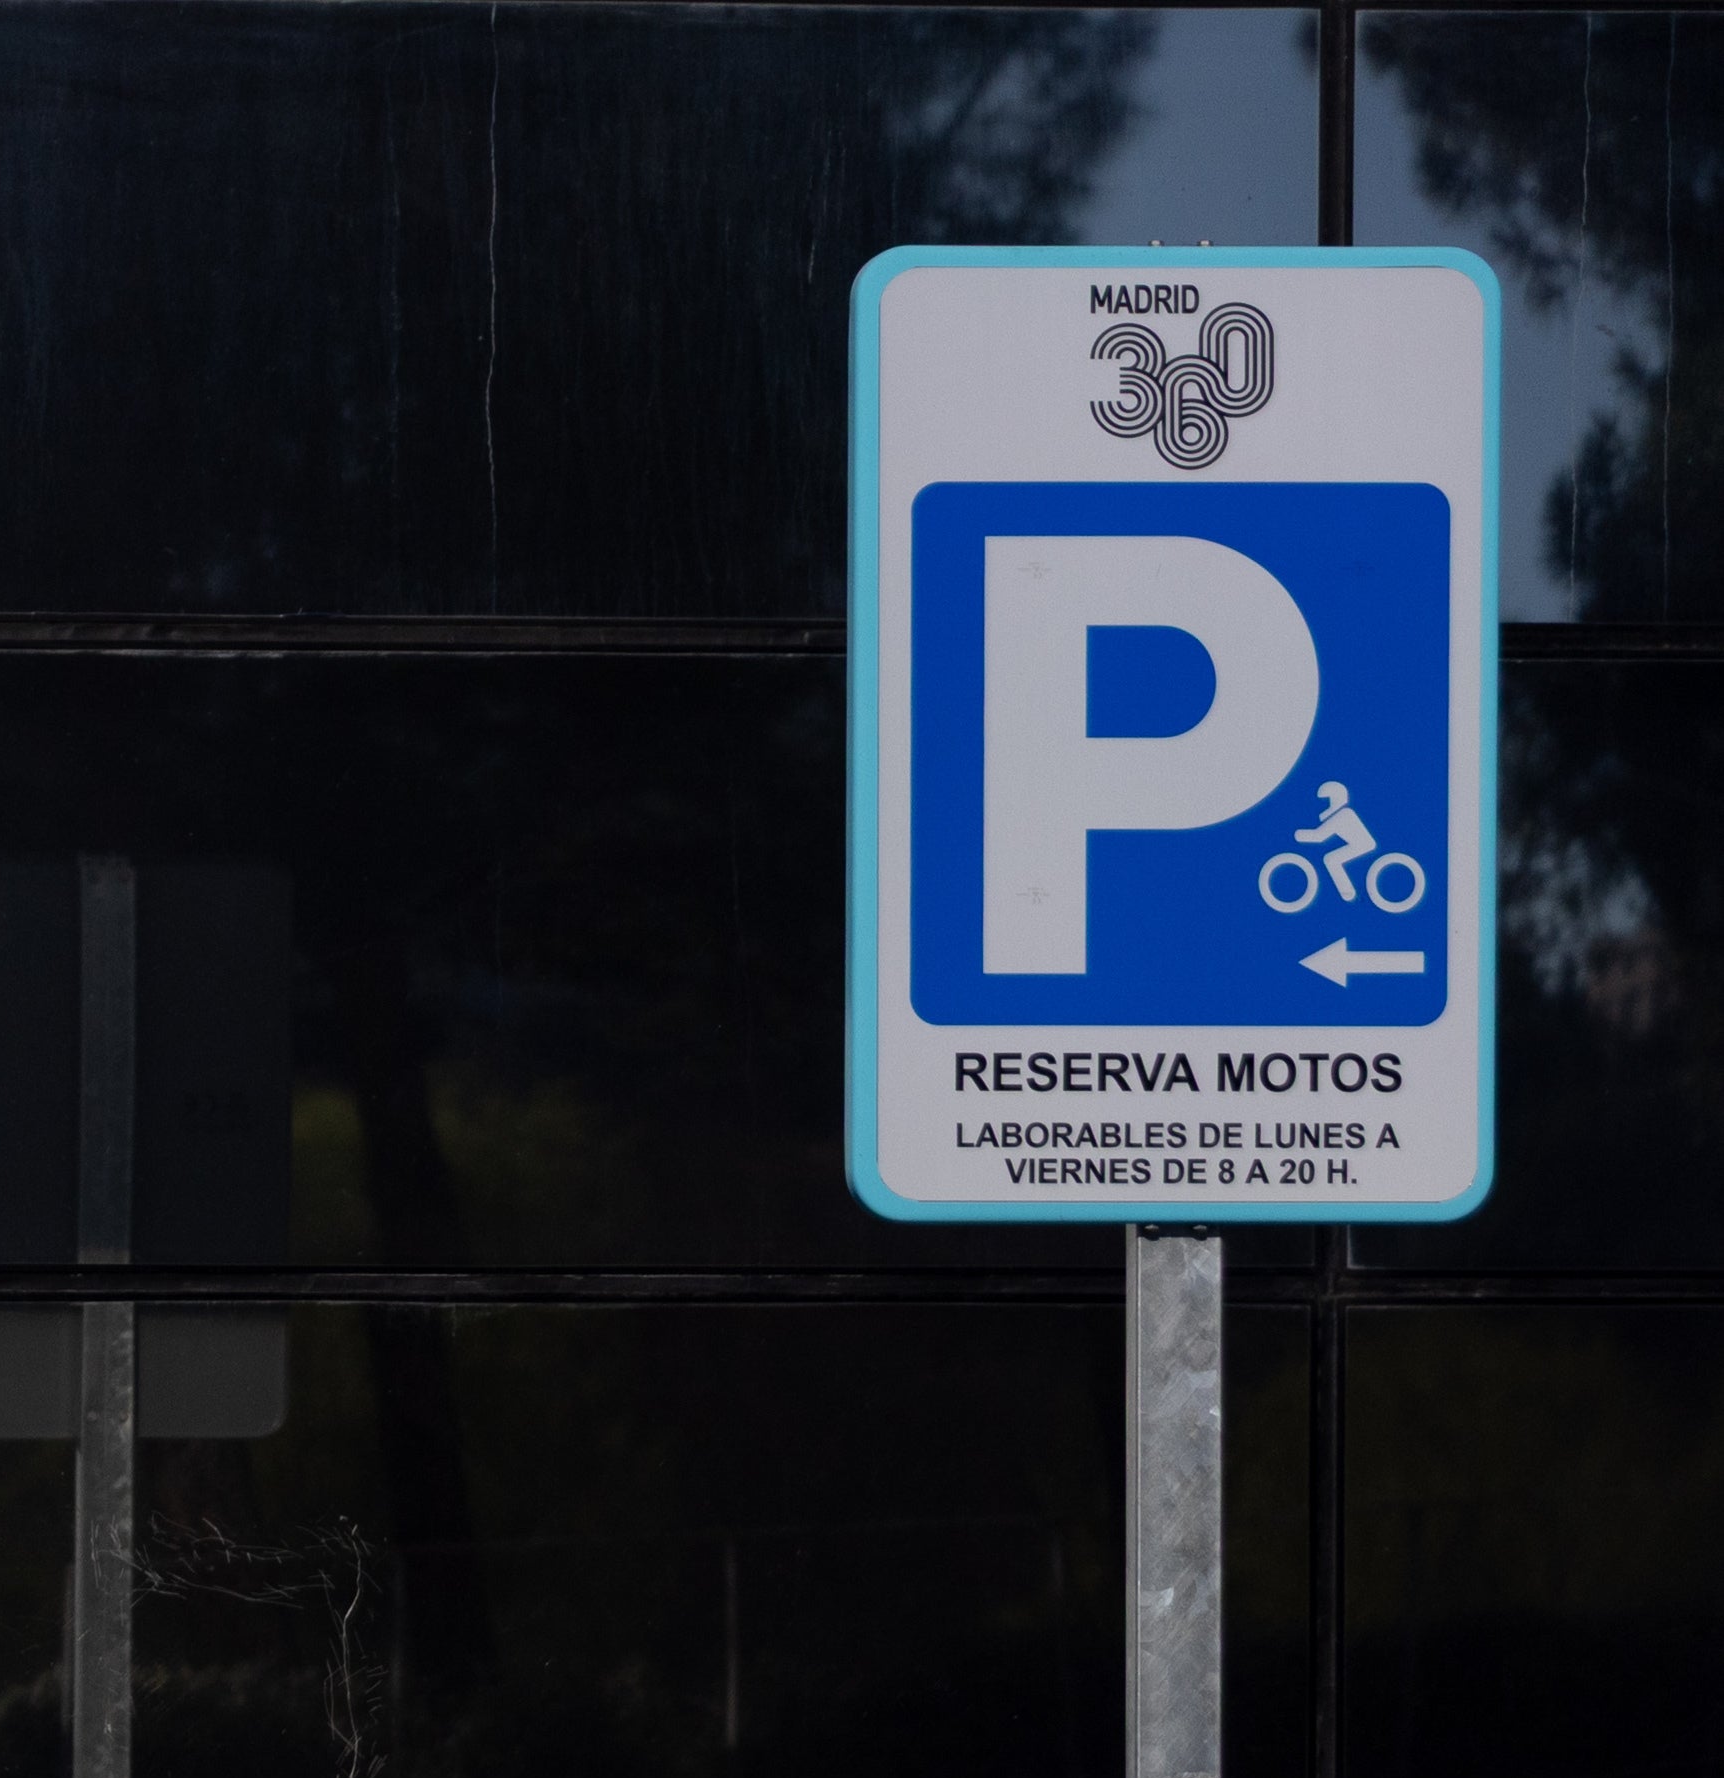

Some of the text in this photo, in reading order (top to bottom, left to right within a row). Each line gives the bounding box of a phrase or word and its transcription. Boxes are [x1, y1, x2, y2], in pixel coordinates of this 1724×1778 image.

[1091, 285, 1199, 314] MADRID
[1090, 302, 1275, 470] 360
[983, 536, 1320, 975] P
[956, 1053, 1402, 1092] RESERVA MOTOS
[956, 1122, 1399, 1150] LABORABLES DE LUNES A
[1005, 1159, 1357, 1185] VIERNES DE 8 A 20 H.
